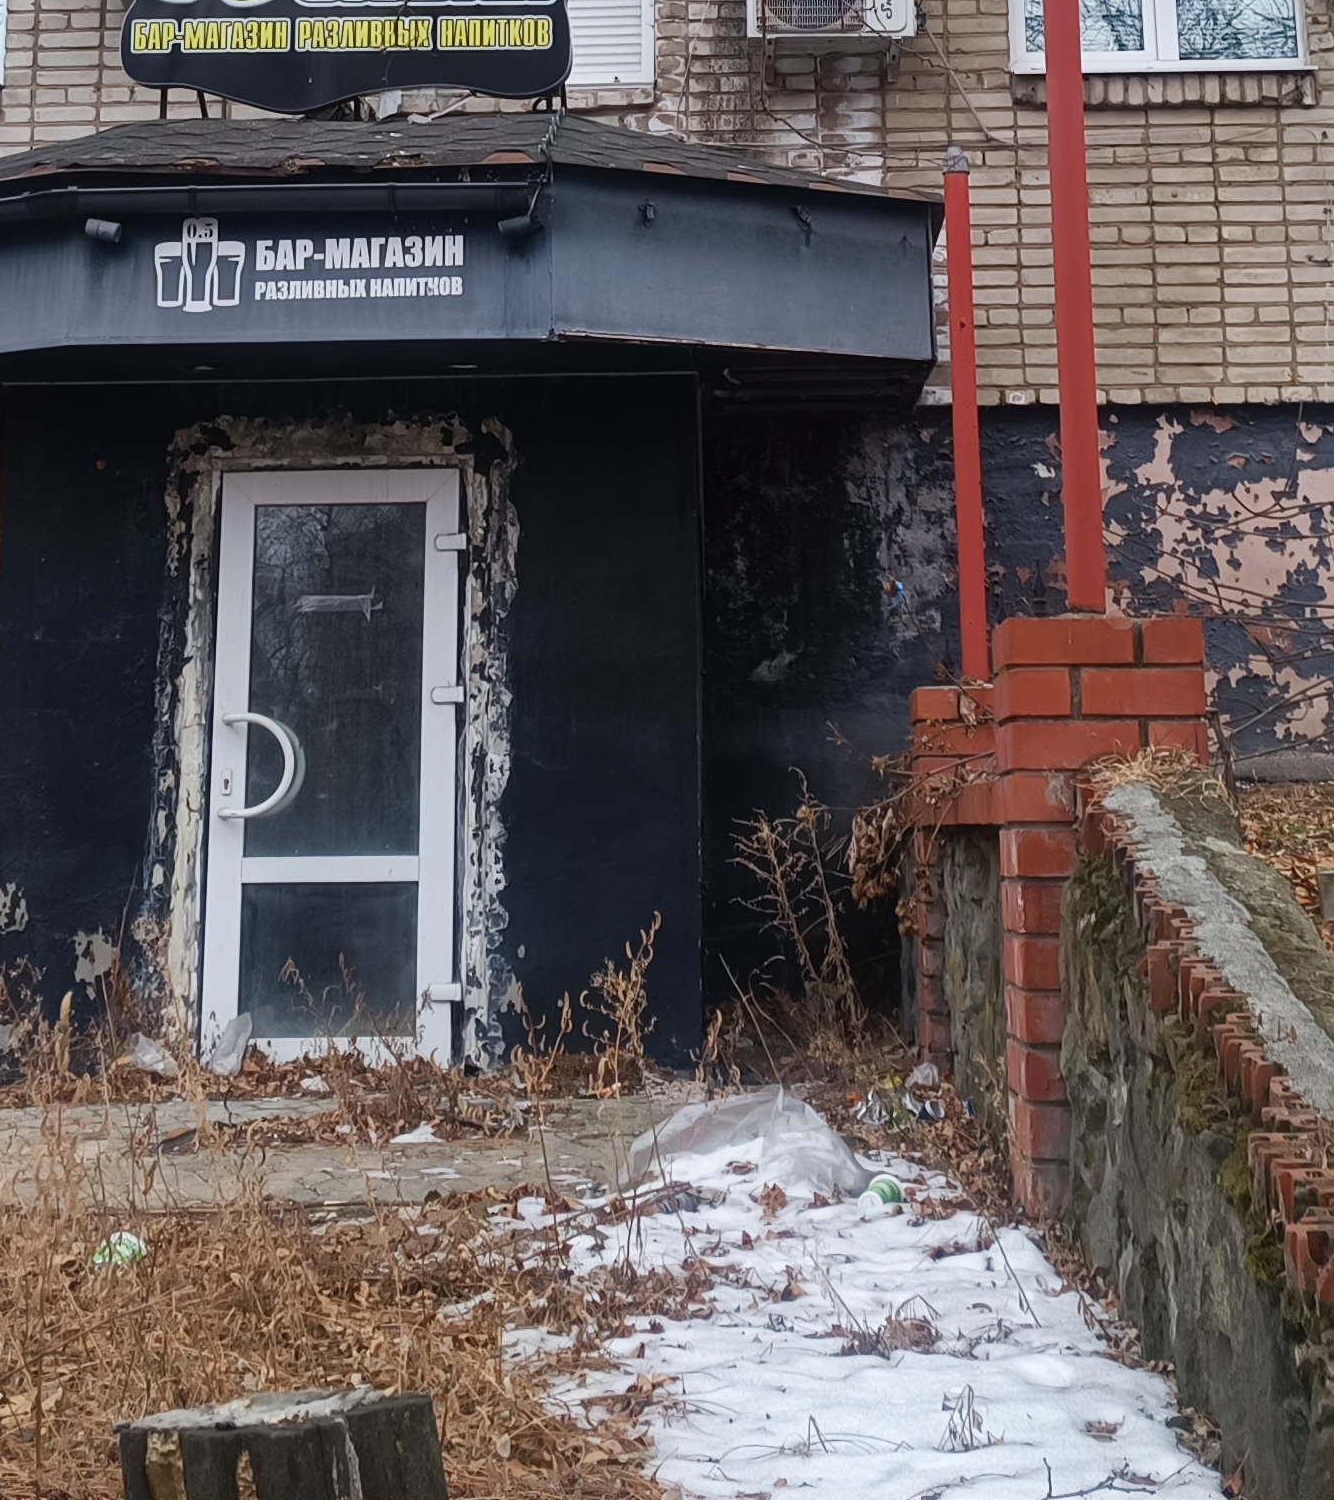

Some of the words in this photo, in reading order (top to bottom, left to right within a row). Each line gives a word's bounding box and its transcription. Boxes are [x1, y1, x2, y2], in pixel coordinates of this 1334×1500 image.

[133, 19, 289, 51] БАР-МАГАЗИН
[298, 19, 431, 50] РАЗЛИВНЫХ
[439, 18, 551, 48] НАПИТКОВ
[187, 222, 214, 239] 0.5
[255, 235, 464, 272] БАР-МАГАЗИН
[253, 276, 367, 301] РАЗЛИВНЫХ
[369, 276, 464, 298] НАПИТКОВ
